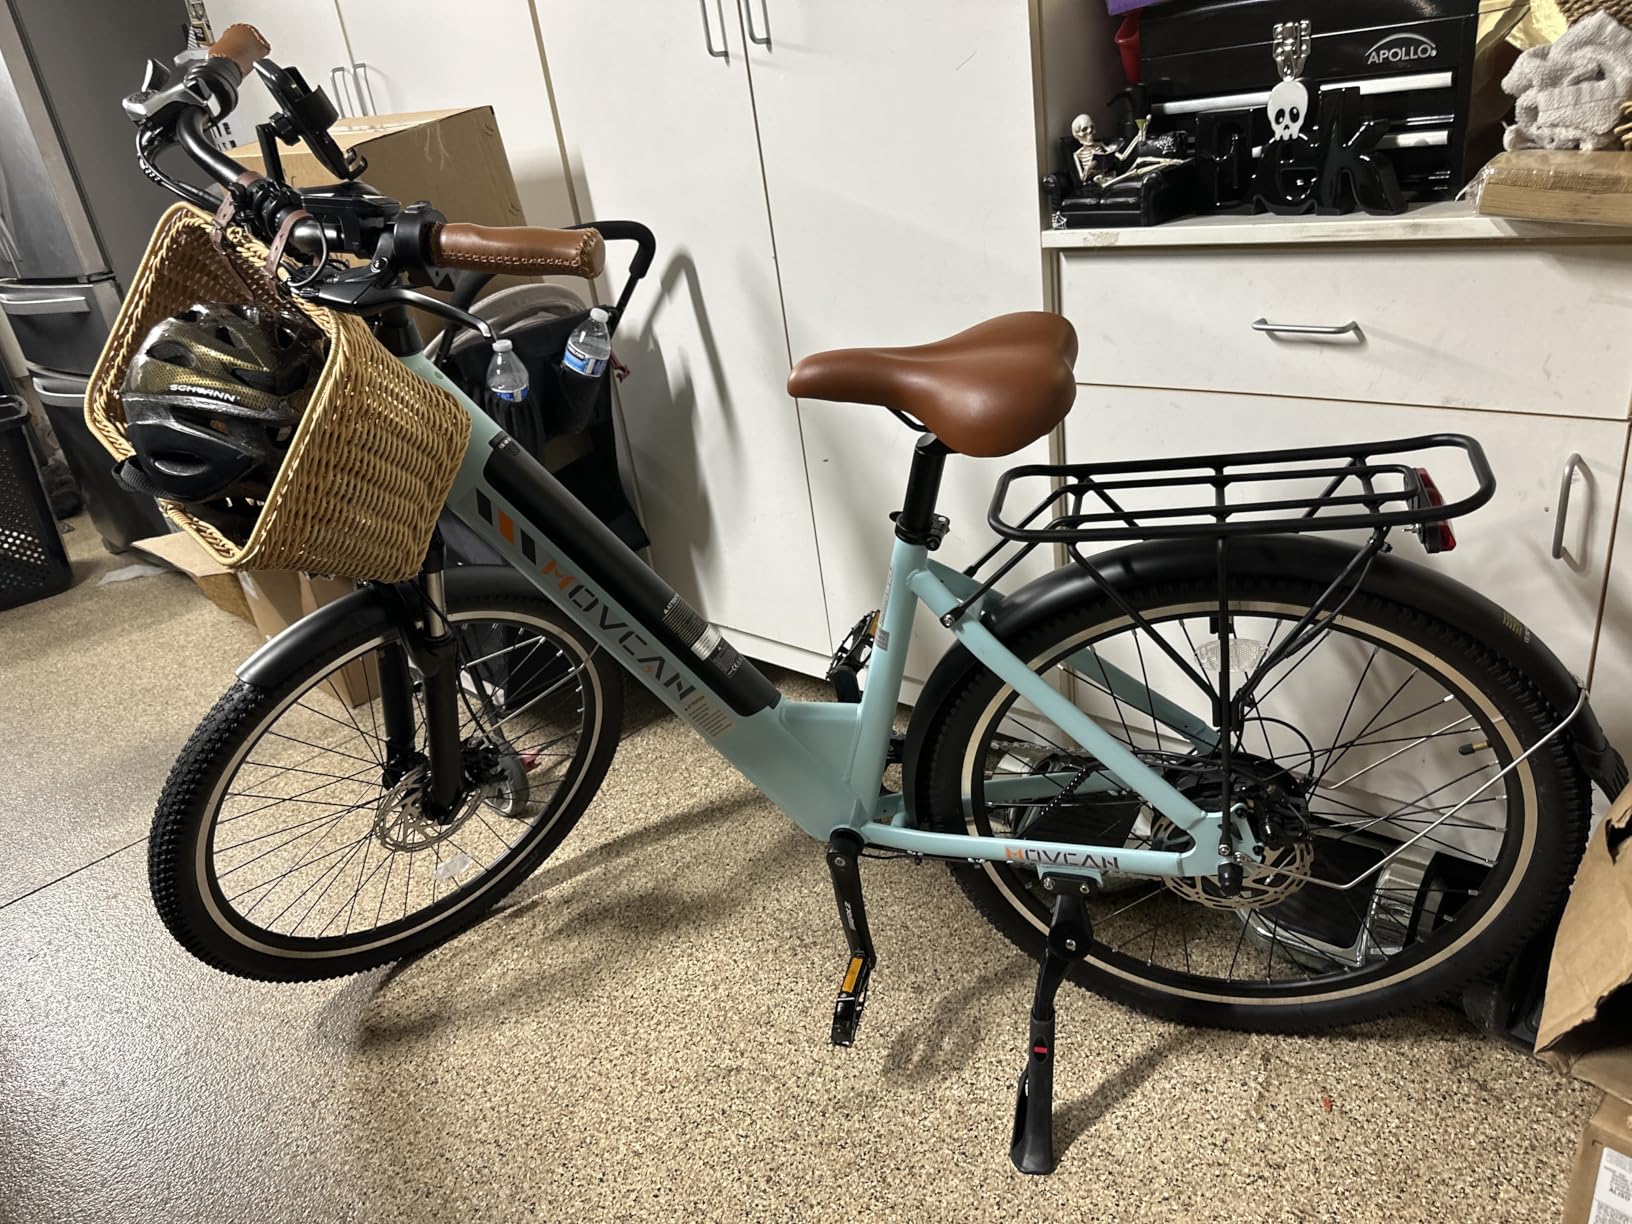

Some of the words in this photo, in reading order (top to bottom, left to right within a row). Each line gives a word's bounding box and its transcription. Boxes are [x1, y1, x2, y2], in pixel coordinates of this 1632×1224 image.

[1367, 44, 1432, 65] APOLLO
[169, 384, 236, 402] SCHWINN
[541, 559, 697, 701] MOVCAN
[1005, 847, 1119, 870] MOVCAN
